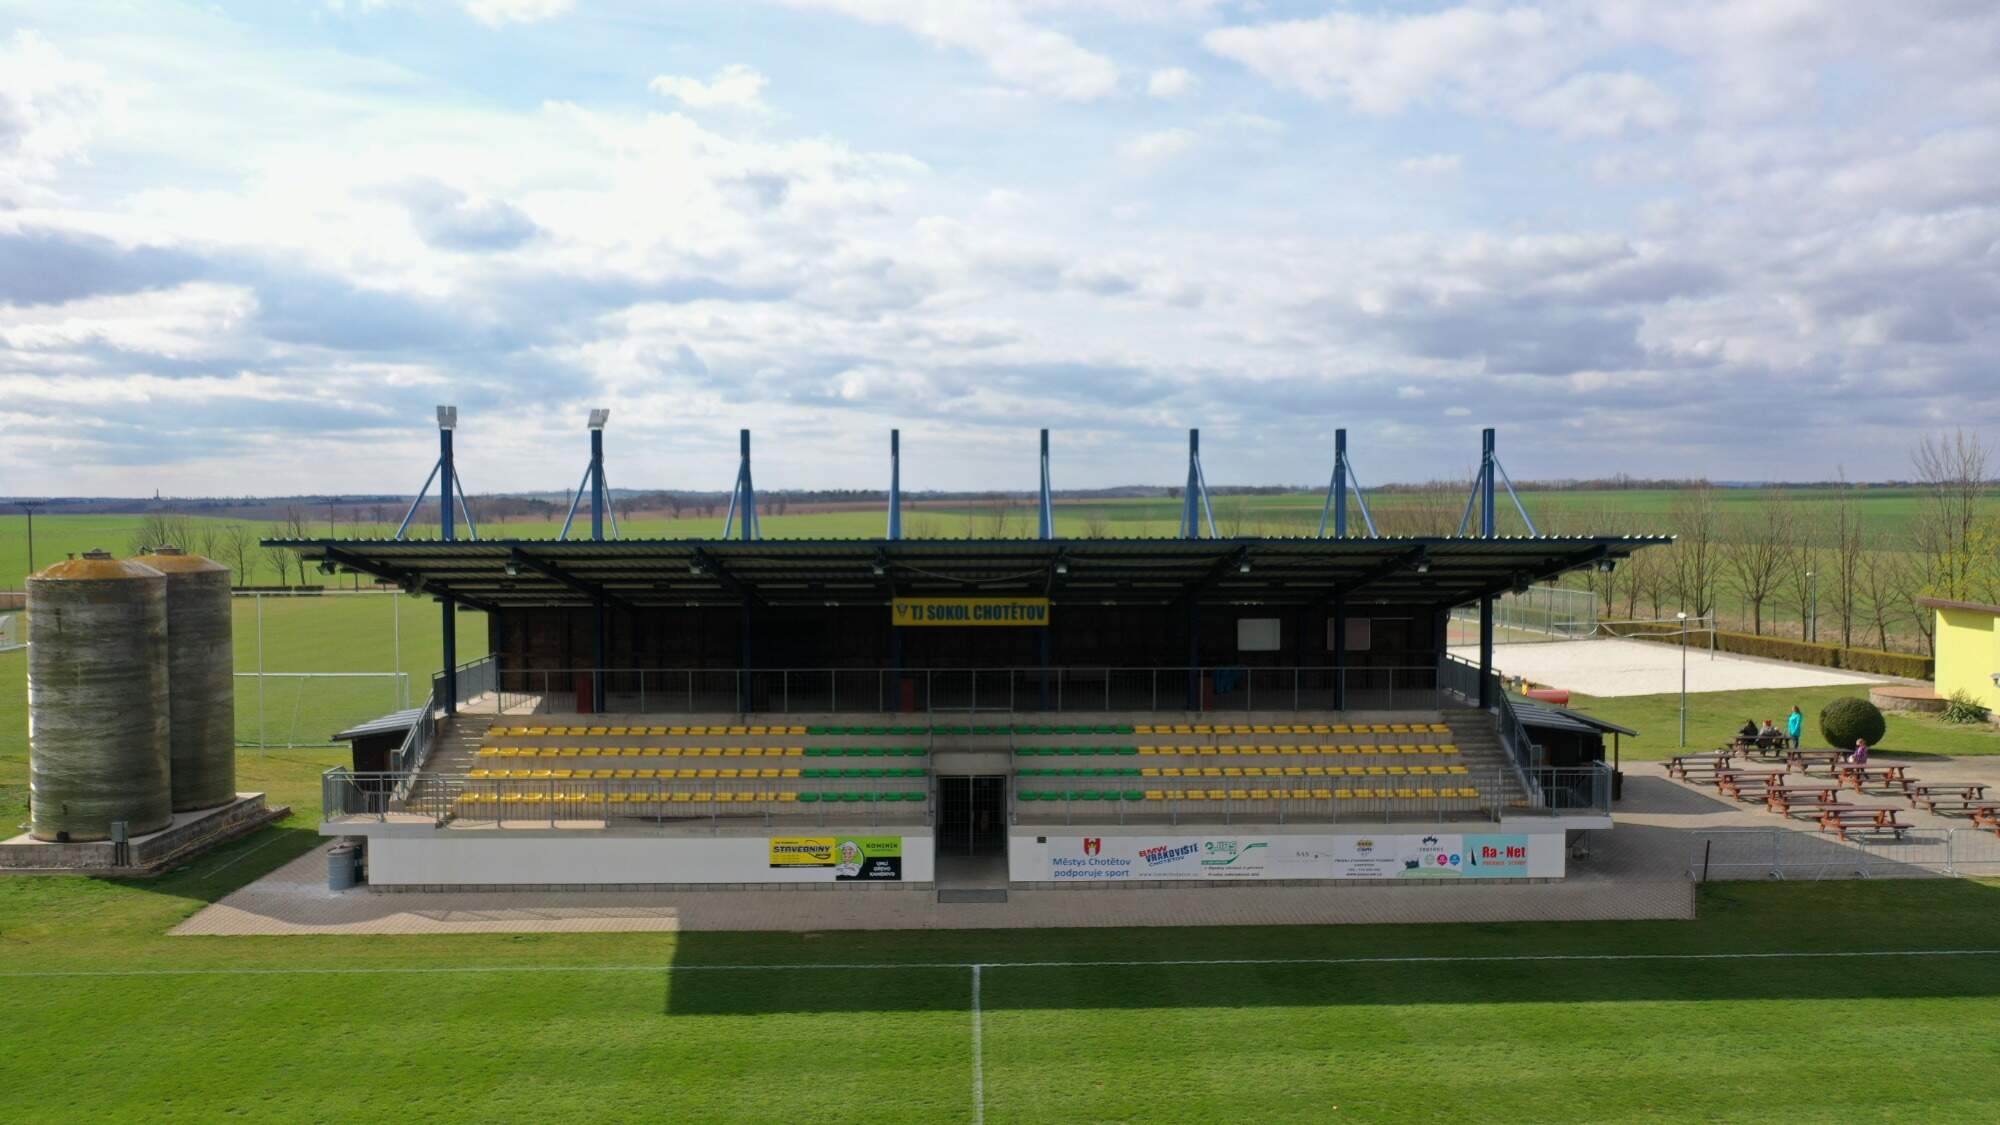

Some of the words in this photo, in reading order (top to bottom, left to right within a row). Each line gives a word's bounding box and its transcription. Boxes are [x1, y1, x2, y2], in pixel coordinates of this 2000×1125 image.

[911, 604, 924, 620] TJ
[927, 604, 970, 621] SOKOL
[973, 602, 1046, 621] CHOTĚTOV
[773, 845, 831, 853] STAVEBNINY
[1482, 846, 1497, 858] Ra
[1506, 846, 1526, 858] Net
[1052, 858, 1086, 867] Městys
[1088, 858, 1131, 866] Chotětov
[1054, 869, 1104, 878] podporuje
[1105, 869, 1130, 878] sport
